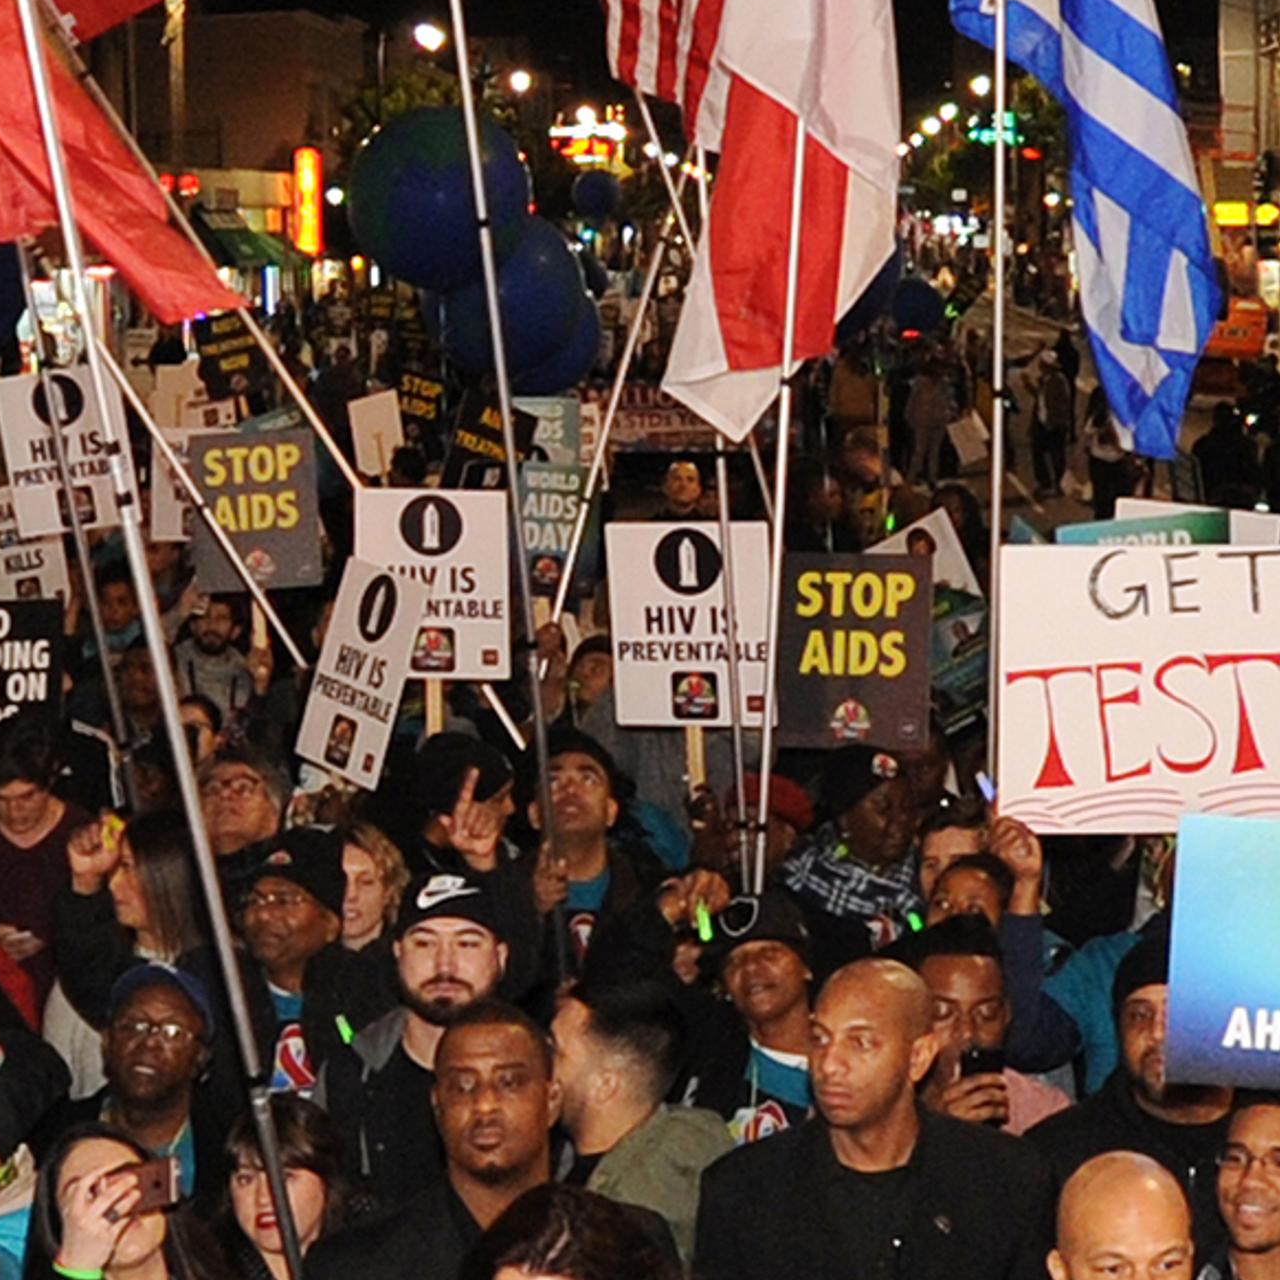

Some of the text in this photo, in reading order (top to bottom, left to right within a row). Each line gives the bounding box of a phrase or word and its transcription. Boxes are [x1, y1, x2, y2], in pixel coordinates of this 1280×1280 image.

[202, 443, 300, 487] STOP
[214, 491, 300, 532] AIDS
[522, 492, 579, 519] AIDS
[451, 566, 476, 594] IS
[795, 570, 916, 618] STOP
[424, 599, 504, 620] NTABLE
[645, 606, 697, 636] HIV
[618, 641, 769, 663] PREVENTALE
[798, 629, 907, 677] AIDS
[5, 670, 47, 702] ON
